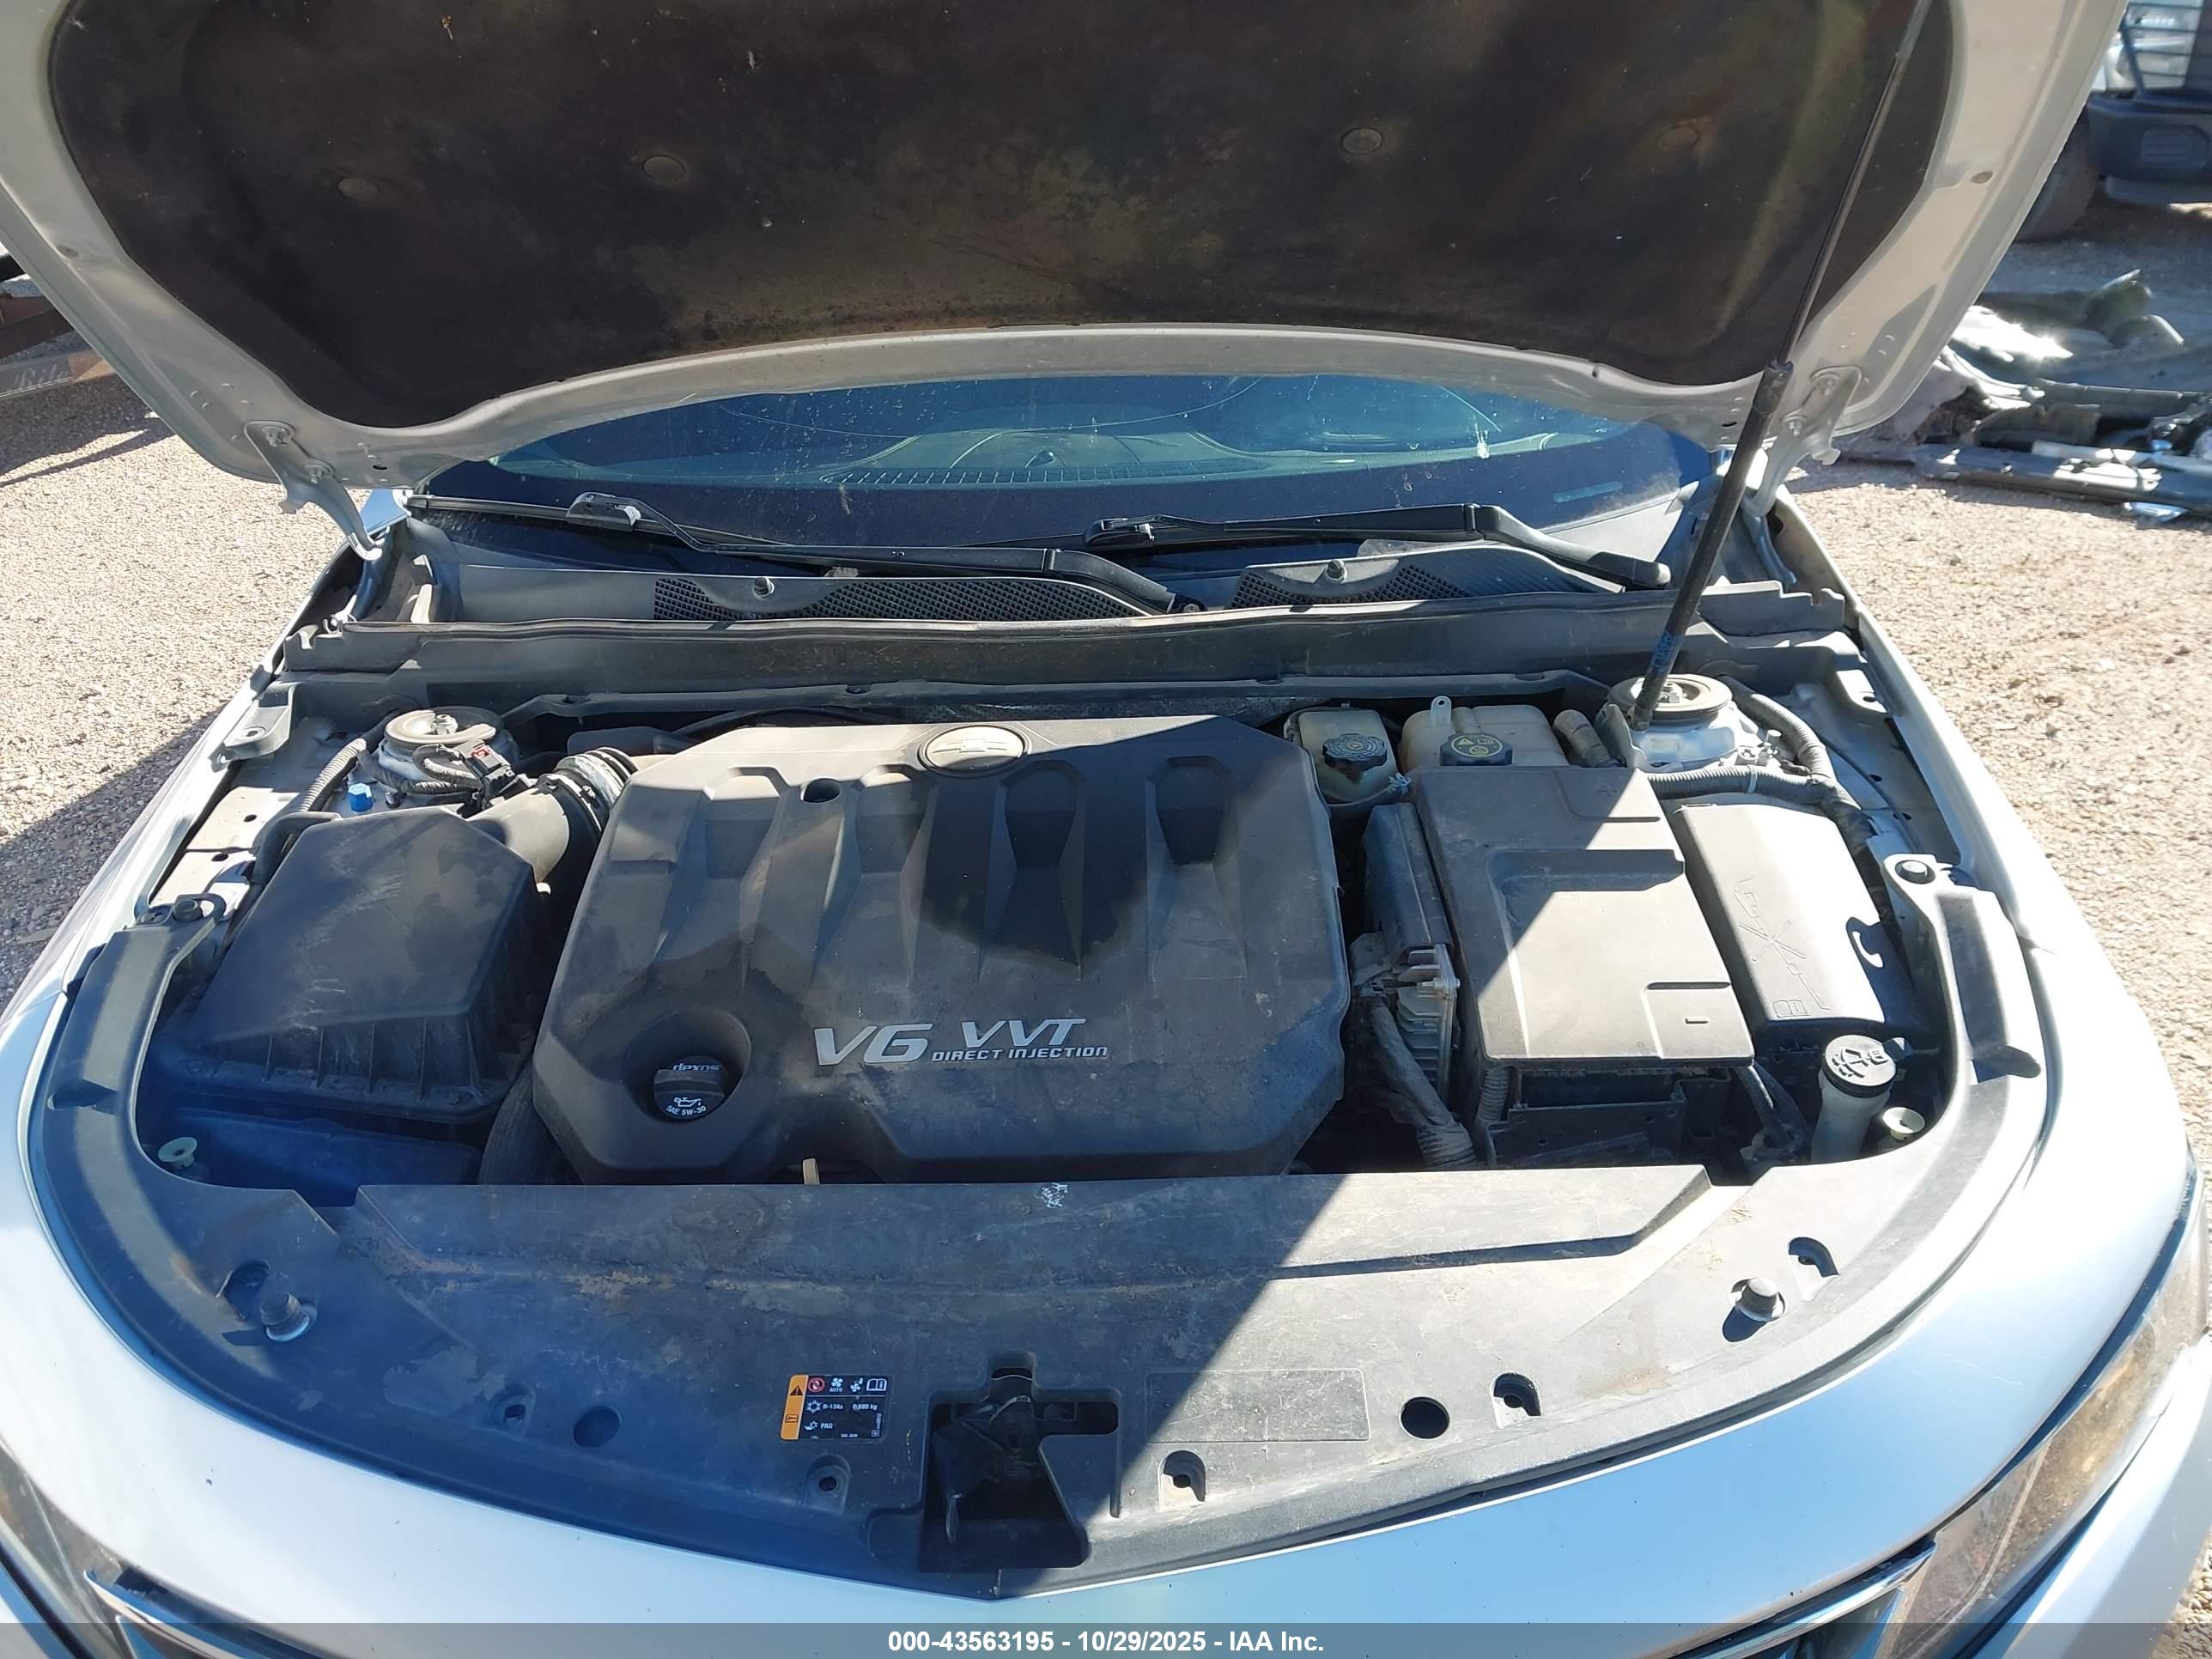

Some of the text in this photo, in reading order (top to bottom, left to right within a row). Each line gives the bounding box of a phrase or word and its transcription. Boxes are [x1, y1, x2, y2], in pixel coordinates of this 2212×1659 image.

[814, 1018, 1086, 1066] V6 VVT
[931, 1046, 1109, 1062] DIRECT INJECTION
[665, 1105, 707, 1115] SAE 5W-30
